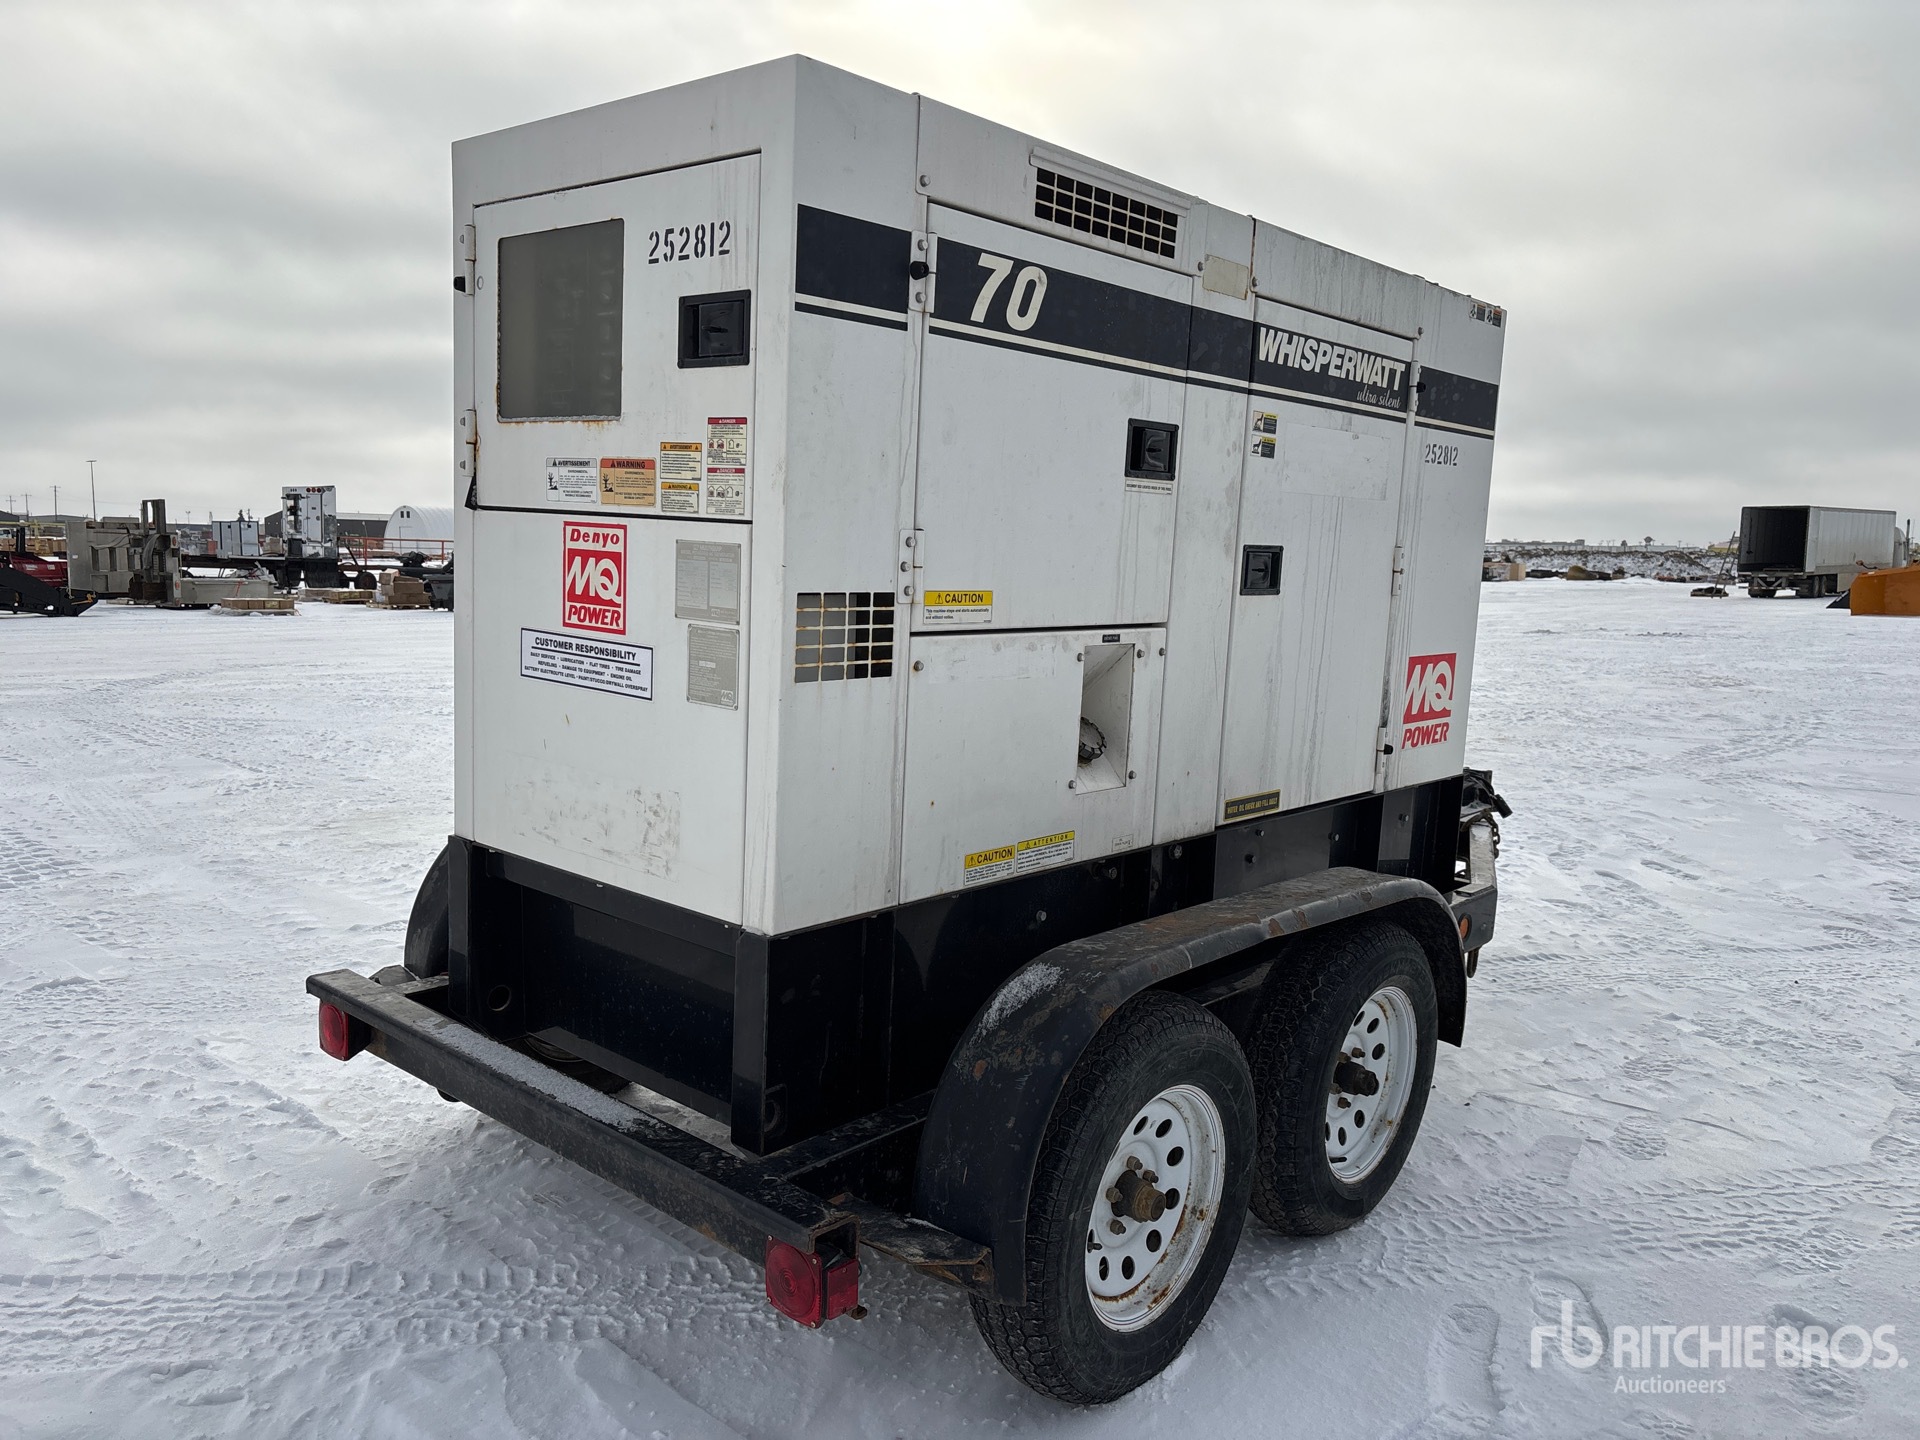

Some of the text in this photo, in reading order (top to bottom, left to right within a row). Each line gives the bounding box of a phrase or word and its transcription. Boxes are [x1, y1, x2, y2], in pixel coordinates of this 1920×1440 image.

[648, 220, 731, 265] 252812
[970, 252, 1048, 331] 70
[1258, 327, 1406, 391] WHISPERWATT
[1357, 384, 1401, 409] ultra silent
[616, 460, 646, 469] WARNING
[1424, 443, 1459, 466] 252812
[570, 528, 620, 548] Denyo
[567, 555, 622, 604] MQ
[944, 593, 984, 604] CAUTION
[567, 604, 621, 627] POWER
[535, 637, 637, 661] CUSTOMER RESPONSIBILITY
[1405, 660, 1453, 715] MQ
[1402, 722, 1450, 749] POWER
[1033, 834, 1068, 846] ATTENTION
[977, 848, 1013, 864] CAUTION
